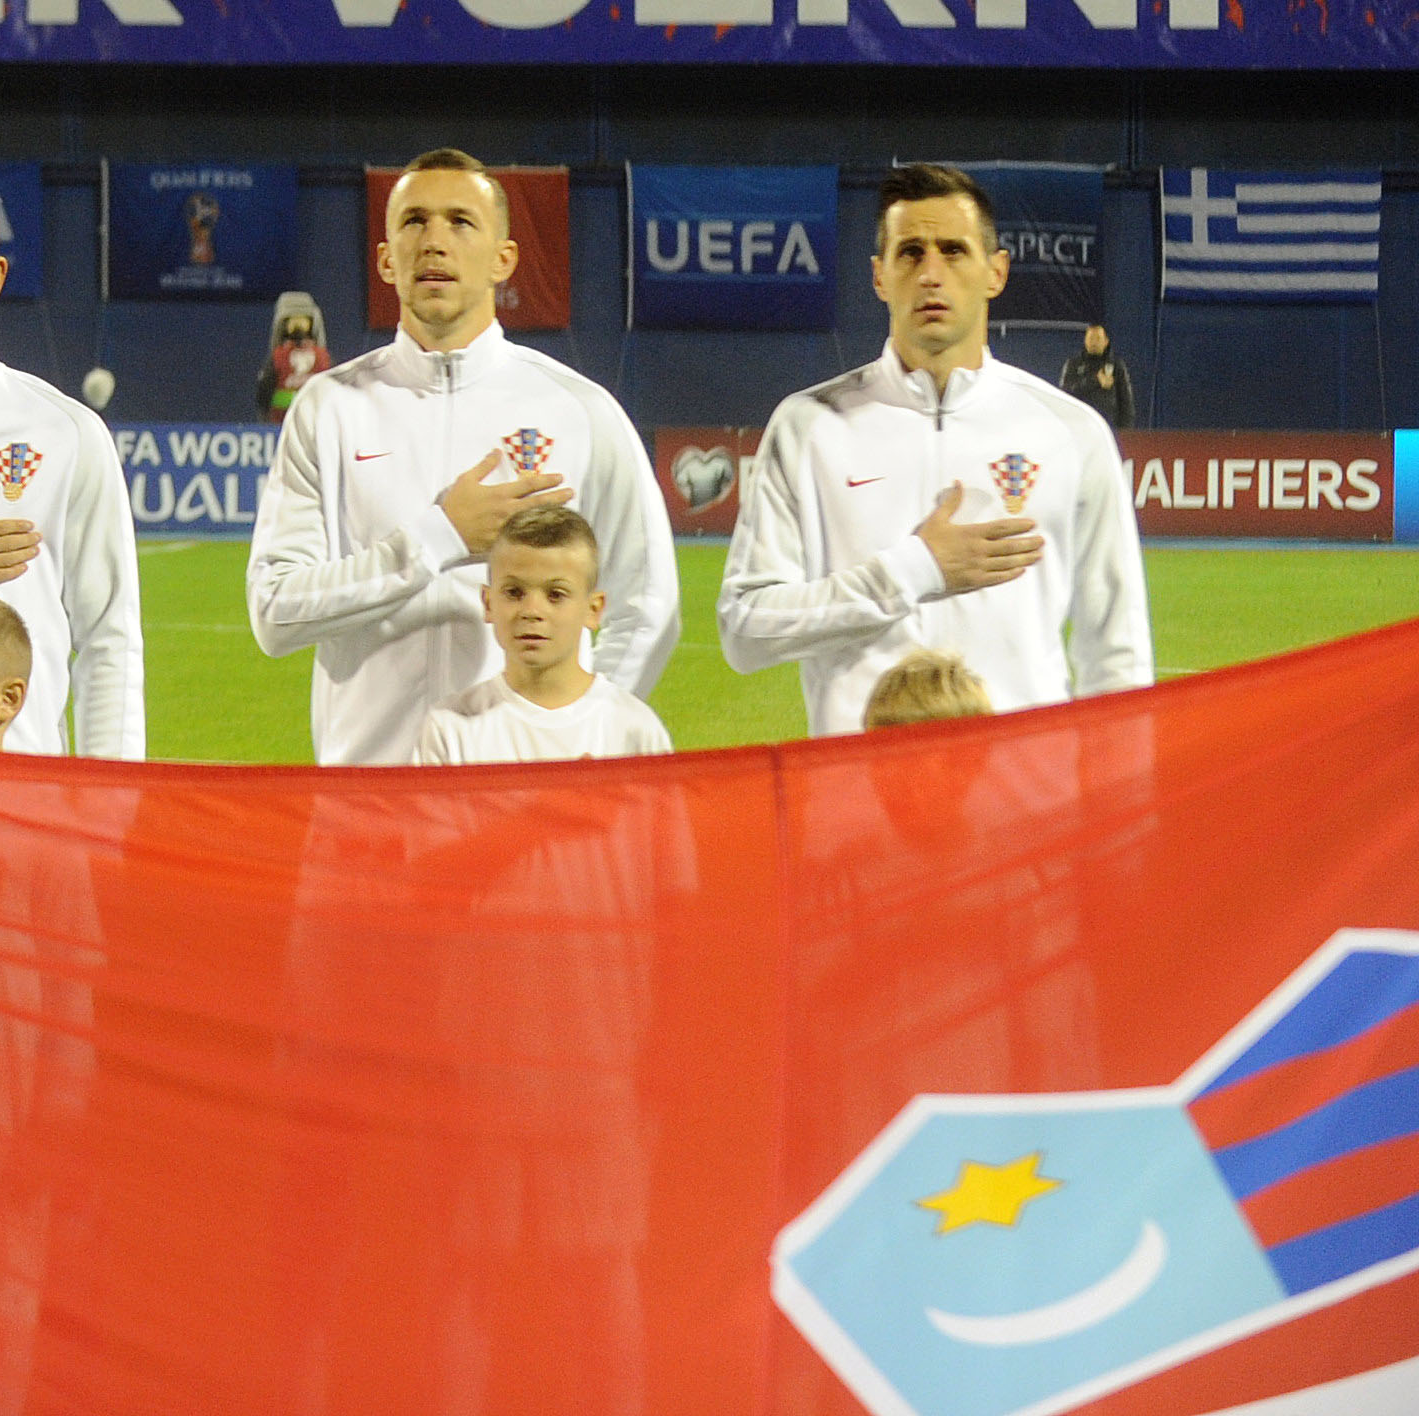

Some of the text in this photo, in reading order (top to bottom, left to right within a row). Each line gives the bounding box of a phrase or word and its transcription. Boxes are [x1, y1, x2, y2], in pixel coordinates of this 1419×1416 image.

[646, 220, 820, 275] UEFA
[999, 231, 1095, 264] SPECT
[115, 430, 277, 467] FA WORL
[130, 472, 265, 523] UAL
[1123, 458, 1381, 511] ALIFIERS
